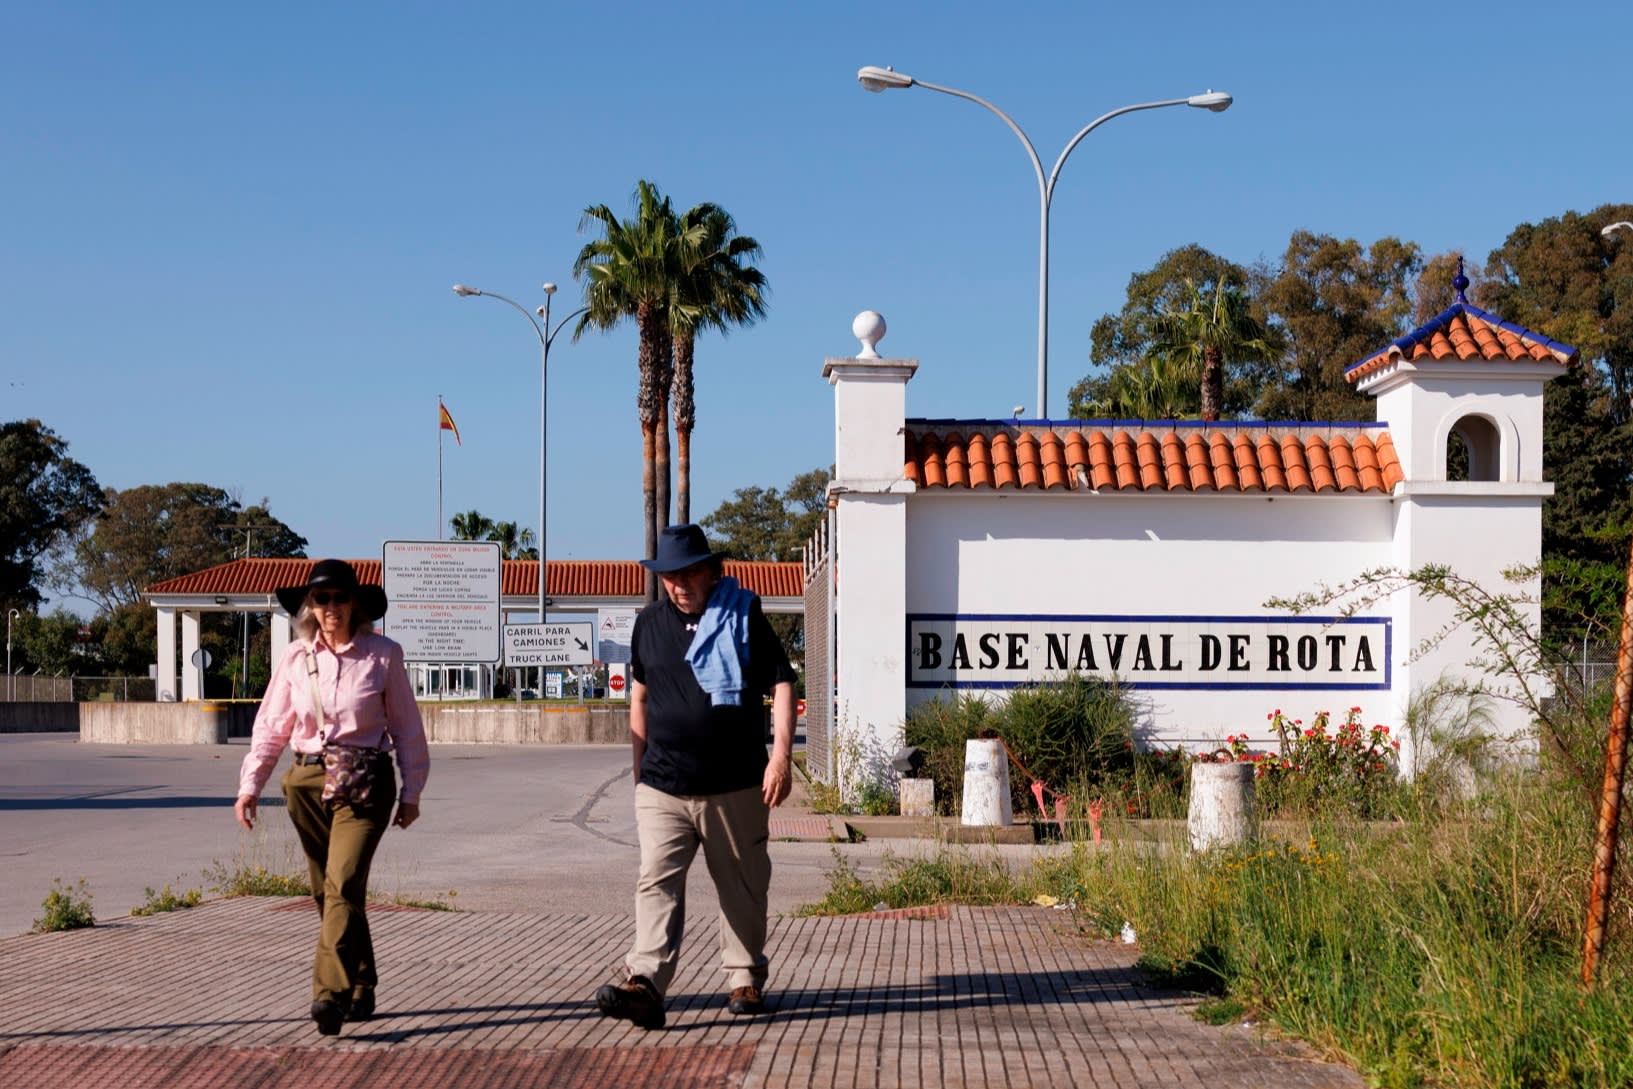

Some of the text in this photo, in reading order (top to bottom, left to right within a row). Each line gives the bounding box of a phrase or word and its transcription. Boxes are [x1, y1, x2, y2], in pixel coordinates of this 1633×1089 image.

[506, 627, 571, 636] CARRIL PARA
[513, 638, 566, 647] CAMIONES
[918, 632, 1377, 672] BASE NAVAL DE ROTA
